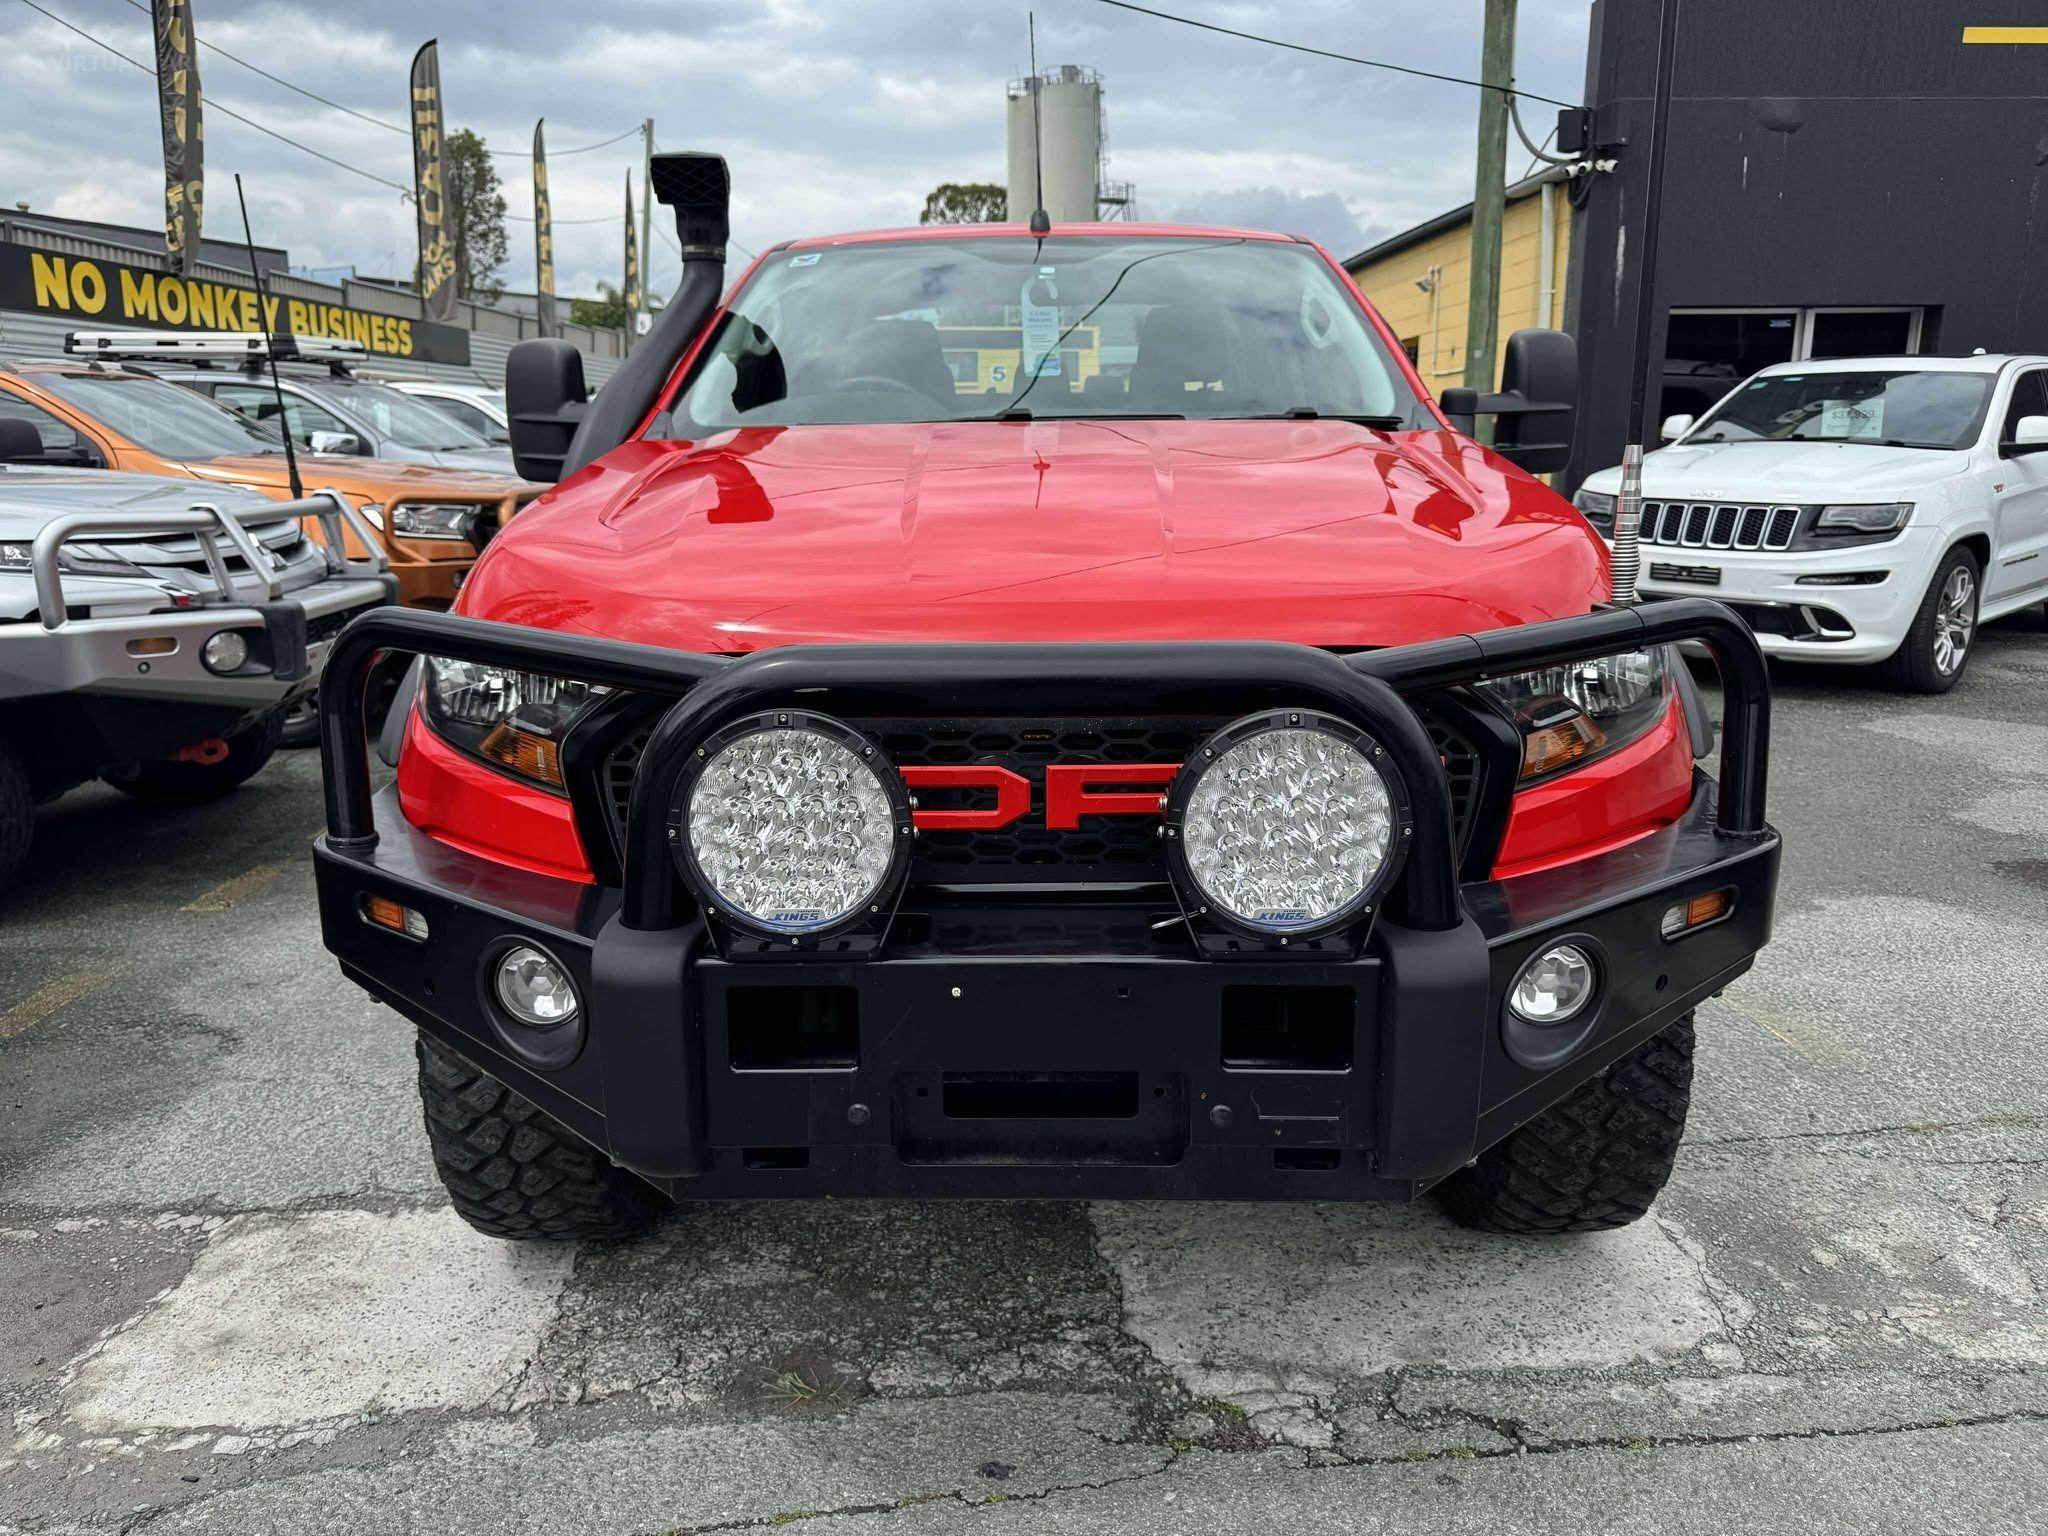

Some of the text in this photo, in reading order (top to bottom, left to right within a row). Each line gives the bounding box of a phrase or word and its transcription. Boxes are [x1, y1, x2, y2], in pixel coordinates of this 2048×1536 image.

[31, 253, 413, 357] NO MONKEY BUSINESS
[991, 366, 1006, 382] 5
[774, 912, 819, 921] KINGS
[1259, 912, 1304, 921] KINGS
